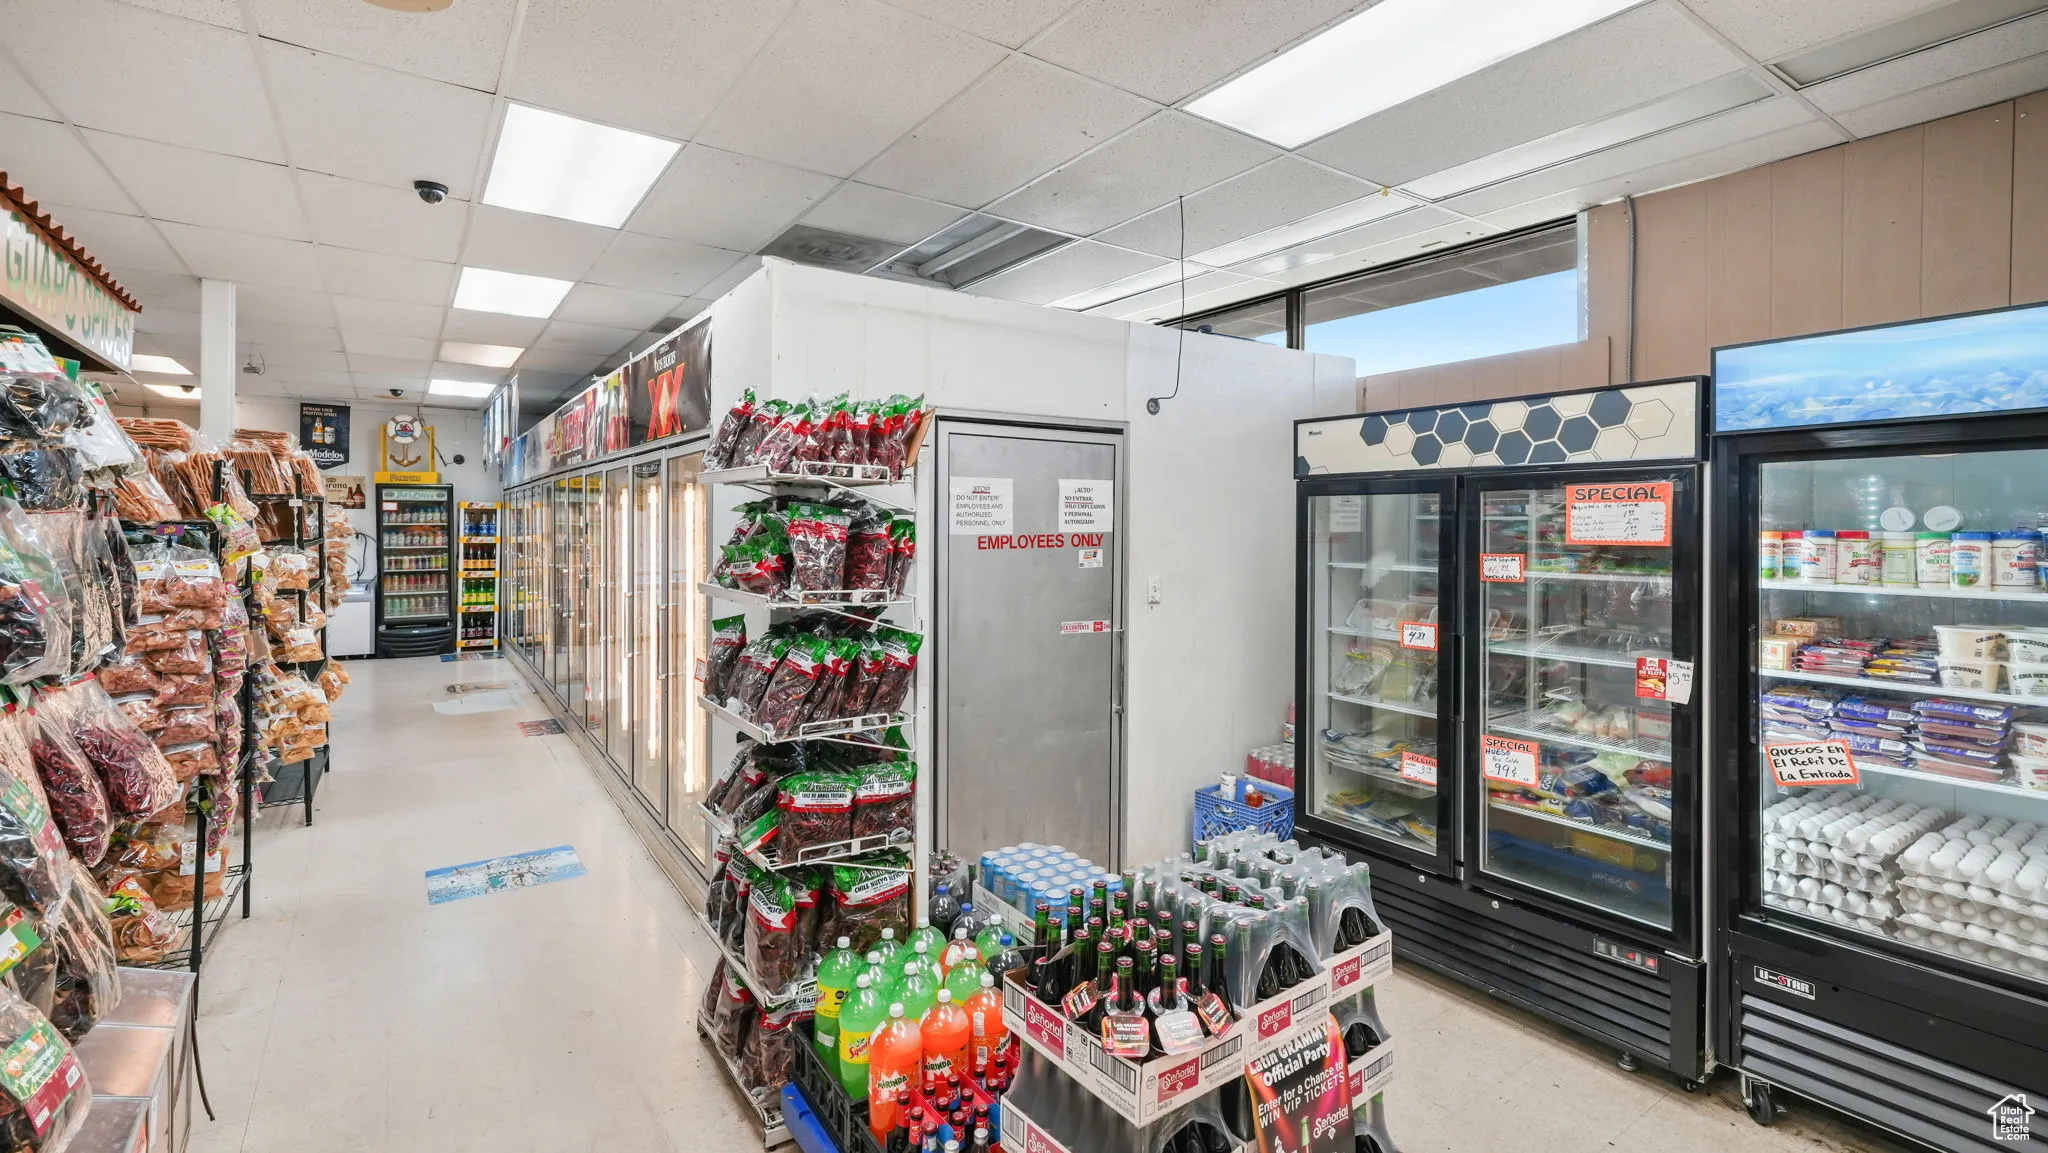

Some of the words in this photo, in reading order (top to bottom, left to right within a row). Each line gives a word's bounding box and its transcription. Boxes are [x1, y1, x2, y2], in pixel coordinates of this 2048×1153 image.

[81, 277, 131, 366] SPICES
[1574, 486, 1662, 501] SPECIAL
[978, 534, 1065, 550] EMPLOYEES
[1071, 533, 1104, 548] ONLY
[1485, 747, 1511, 756] HUESO
[1486, 738, 1532, 753] SPECIAL
[1772, 759, 1787, 769] El
[1828, 757, 1847, 766] De
[1779, 771, 1797, 782] La
[1798, 768, 1853, 780] Entrada
[854, 883, 870, 894] CHILE
[870, 876, 888, 887] NUEVO
[1334, 961, 1359, 982] Señorial
[1759, 969, 1810, 994] U-STAR
[1028, 1004, 1063, 1038] Señorial
[1261, 1005, 1289, 1031] Señorial
[1248, 1048, 1279, 1076] Latin
[1278, 1023, 1329, 1059] GRAMMY
[1163, 1064, 1196, 1089] Señorial
[1263, 1054, 1303, 1087] Official
[1303, 1041, 1331, 1066] Party
[1258, 1095, 1282, 1117] Enter
[1283, 1088, 1296, 1103] for
[1297, 1084, 1303, 1094] a
[1304, 1069, 1334, 1090] Chance
[1334, 1061, 1344, 1073] to
[1259, 1107, 1281, 1129] WIN
[1283, 1097, 1302, 1115] VIP
[1303, 1072, 1345, 1103] TICKETS
[1313, 1104, 1349, 1139] Señorial
